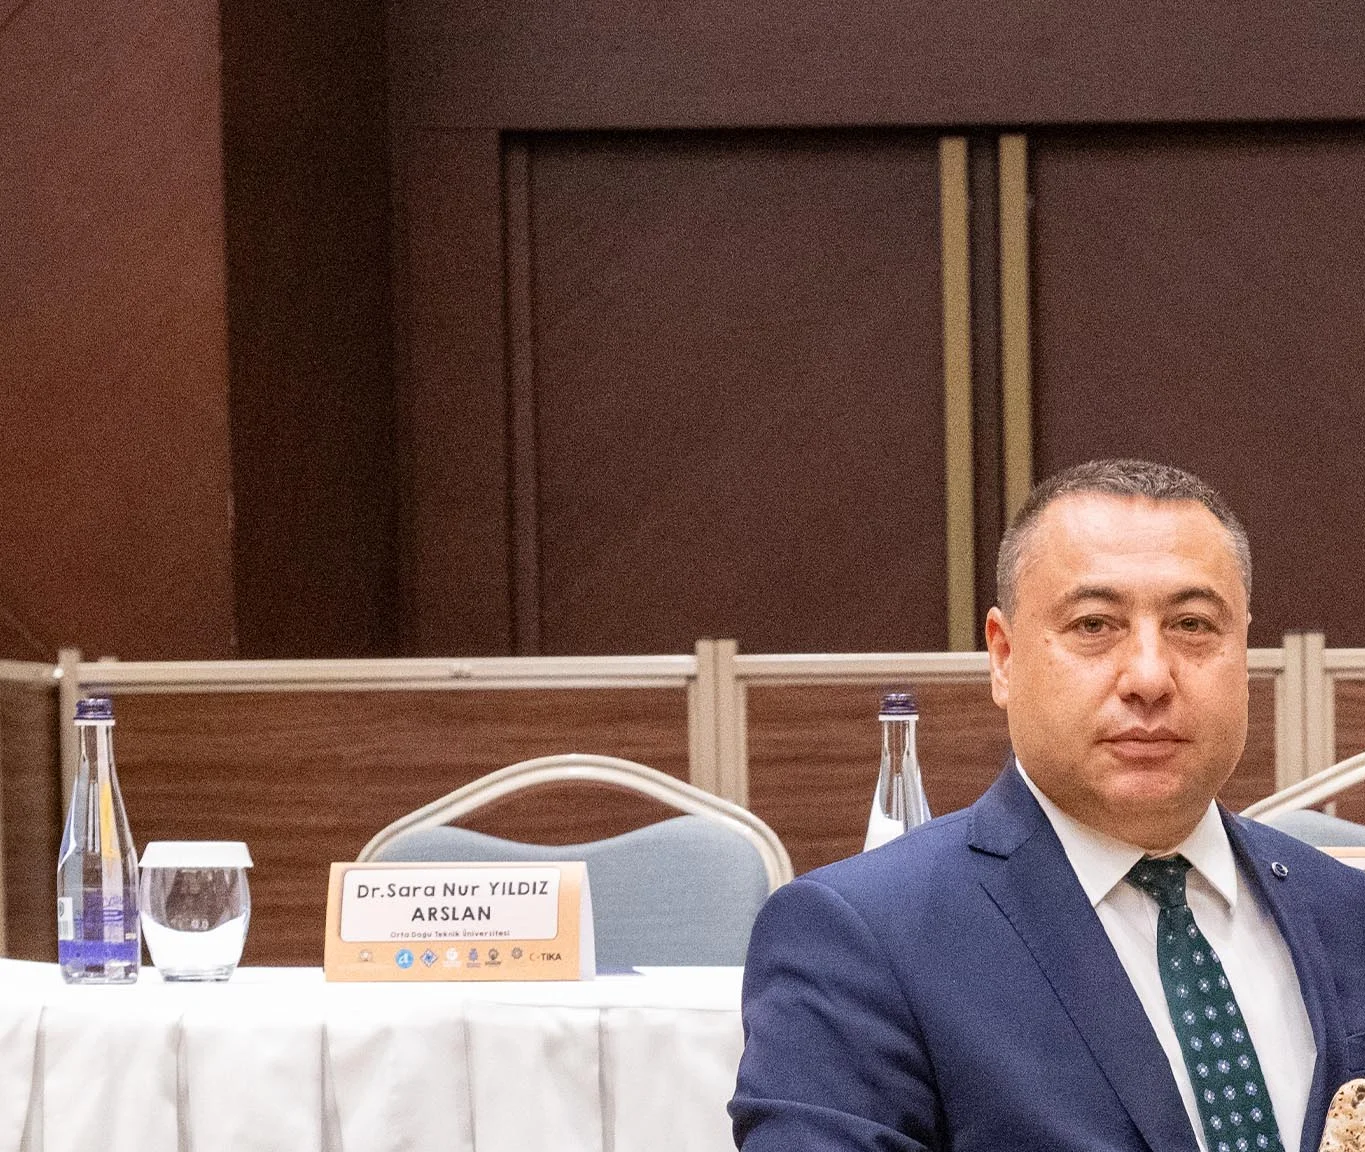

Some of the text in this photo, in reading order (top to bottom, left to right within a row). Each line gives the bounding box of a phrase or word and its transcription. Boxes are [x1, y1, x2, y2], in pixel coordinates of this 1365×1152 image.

[442, 882, 480, 897] Nur
[488, 880, 549, 896] YILDIZ
[410, 906, 492, 922] ARSLAN
